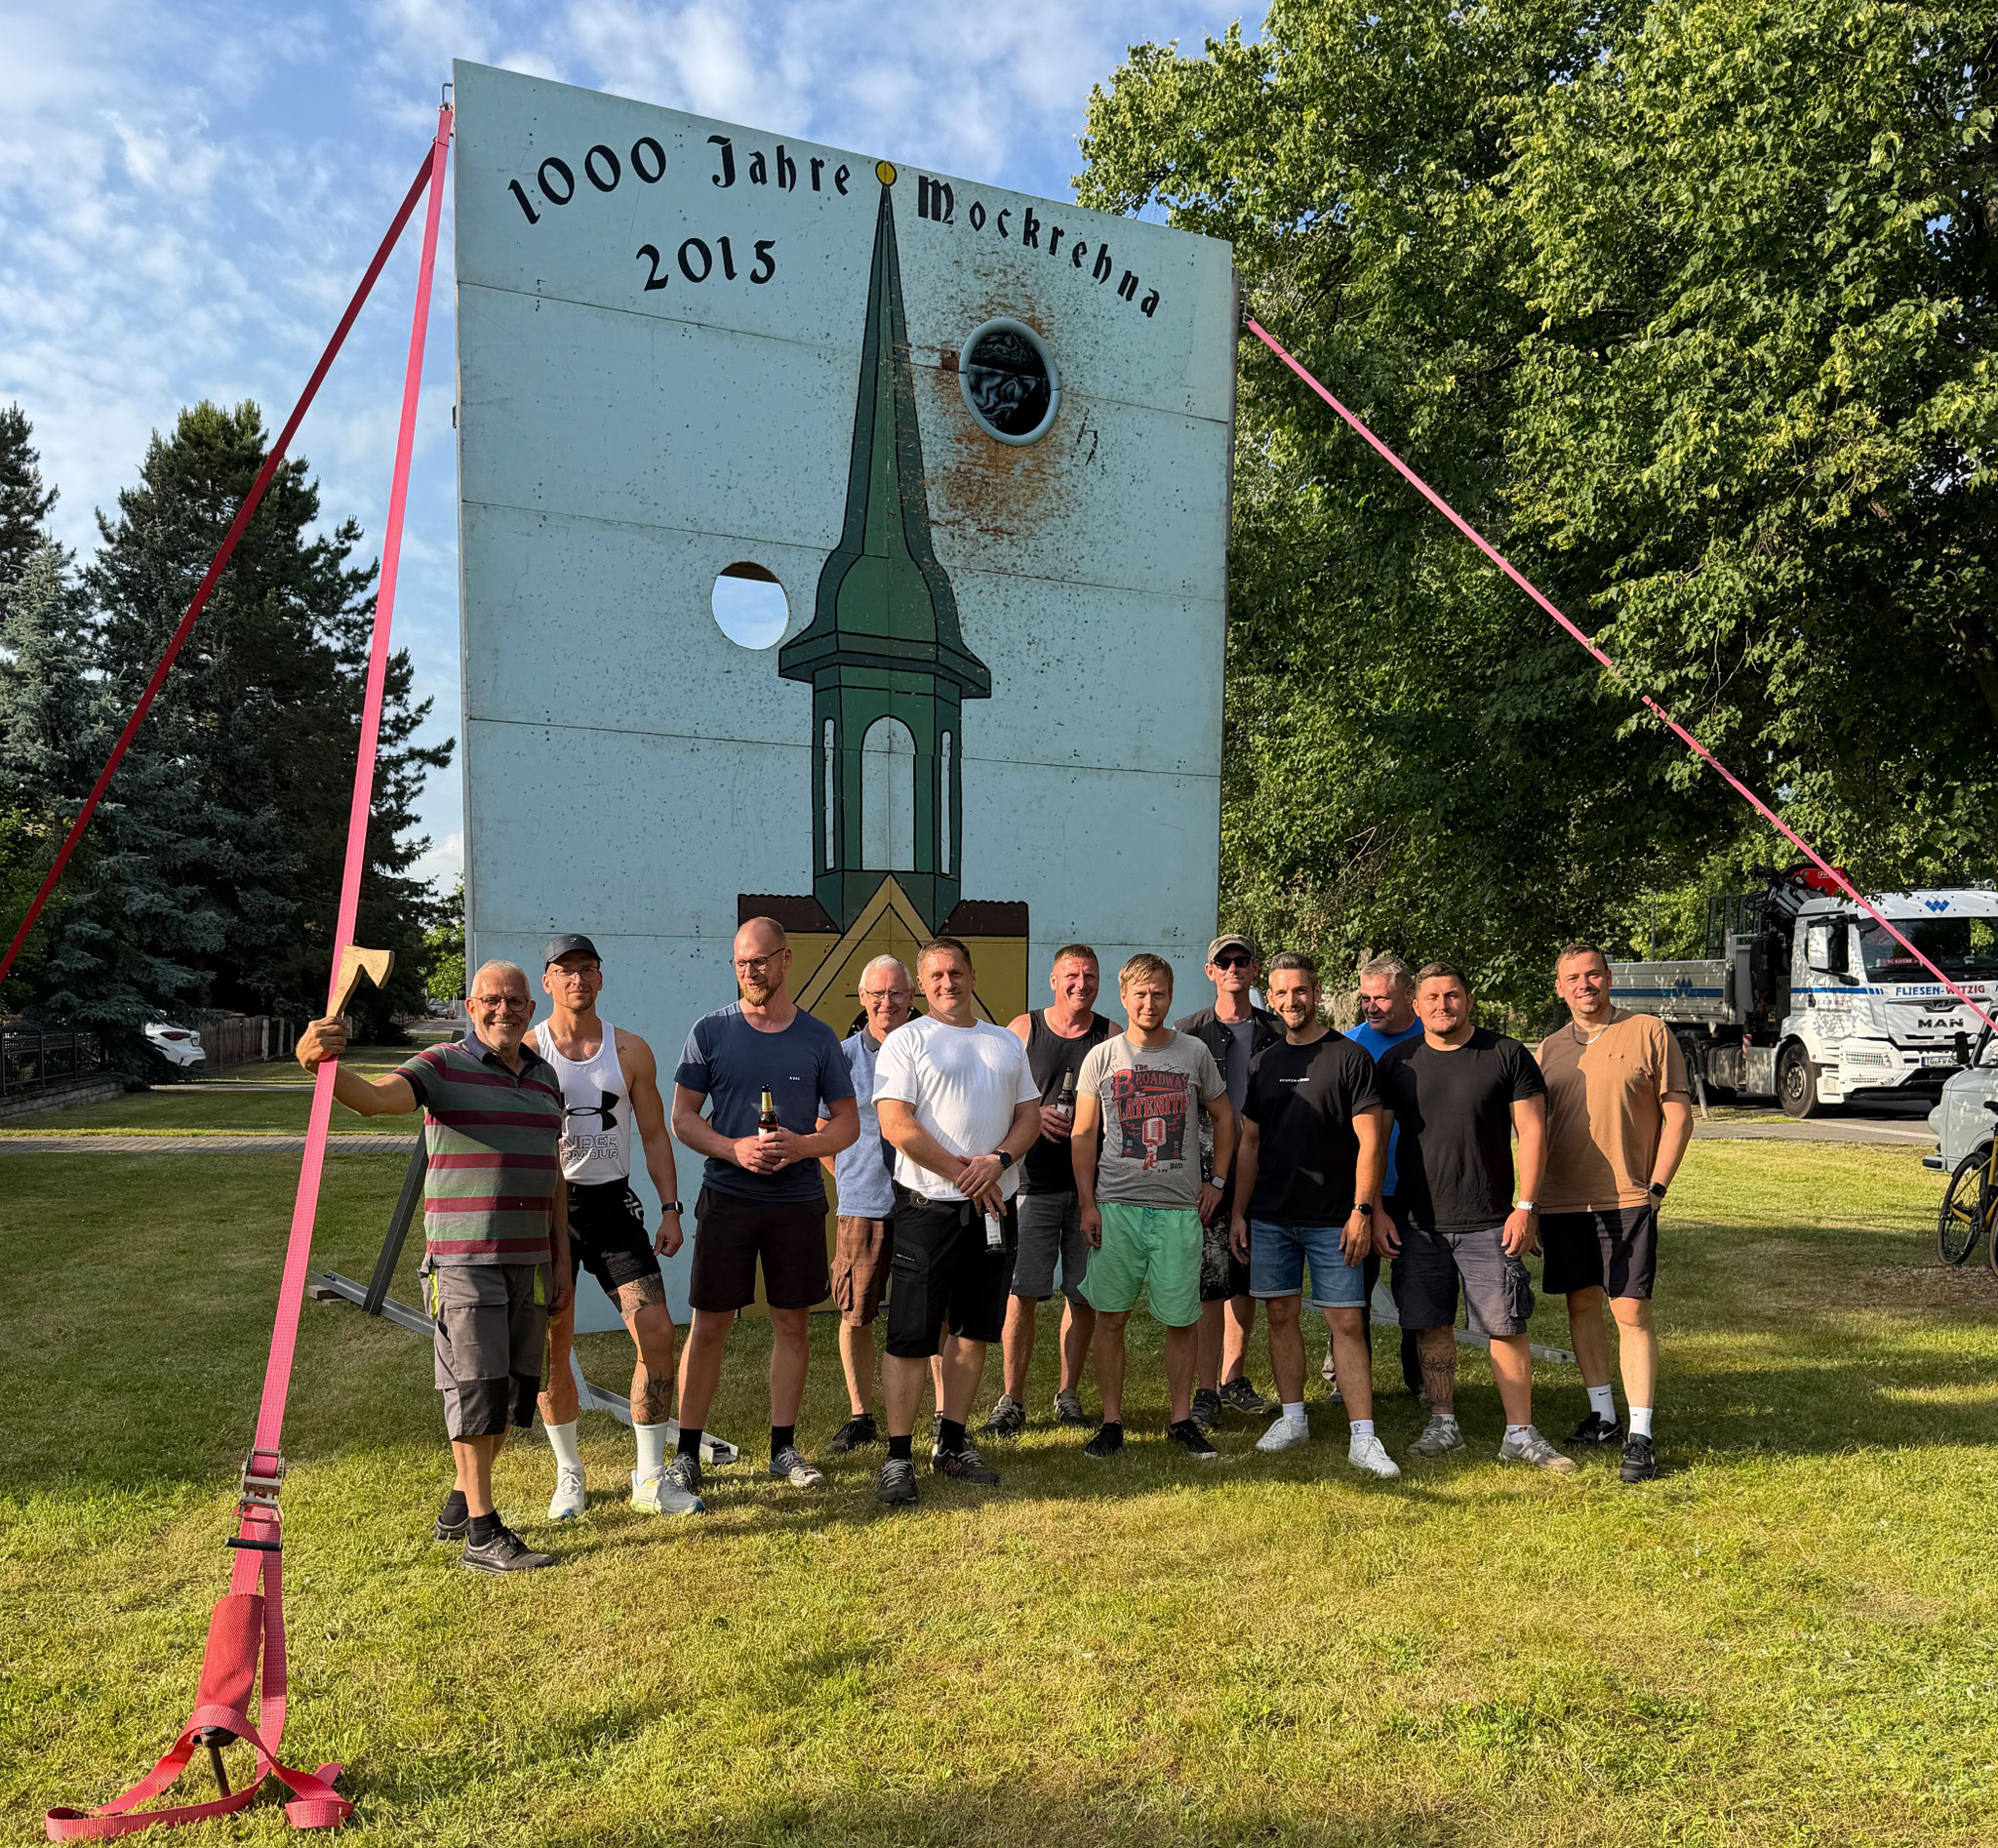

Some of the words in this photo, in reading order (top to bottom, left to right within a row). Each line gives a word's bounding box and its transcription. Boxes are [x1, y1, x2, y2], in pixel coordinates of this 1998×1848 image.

[507, 137, 666, 224] 1000
[706, 135, 851, 196] Jahre
[918, 175, 1160, 318] Mockrehna
[636, 235, 776, 292] 2015
[1896, 984, 1985, 996] FLIESEN-WTZIG
[1918, 1018, 1964, 1028] MAN
[564, 1133, 619, 1148] NDER
[560, 1148, 619, 1161] RMOUR
